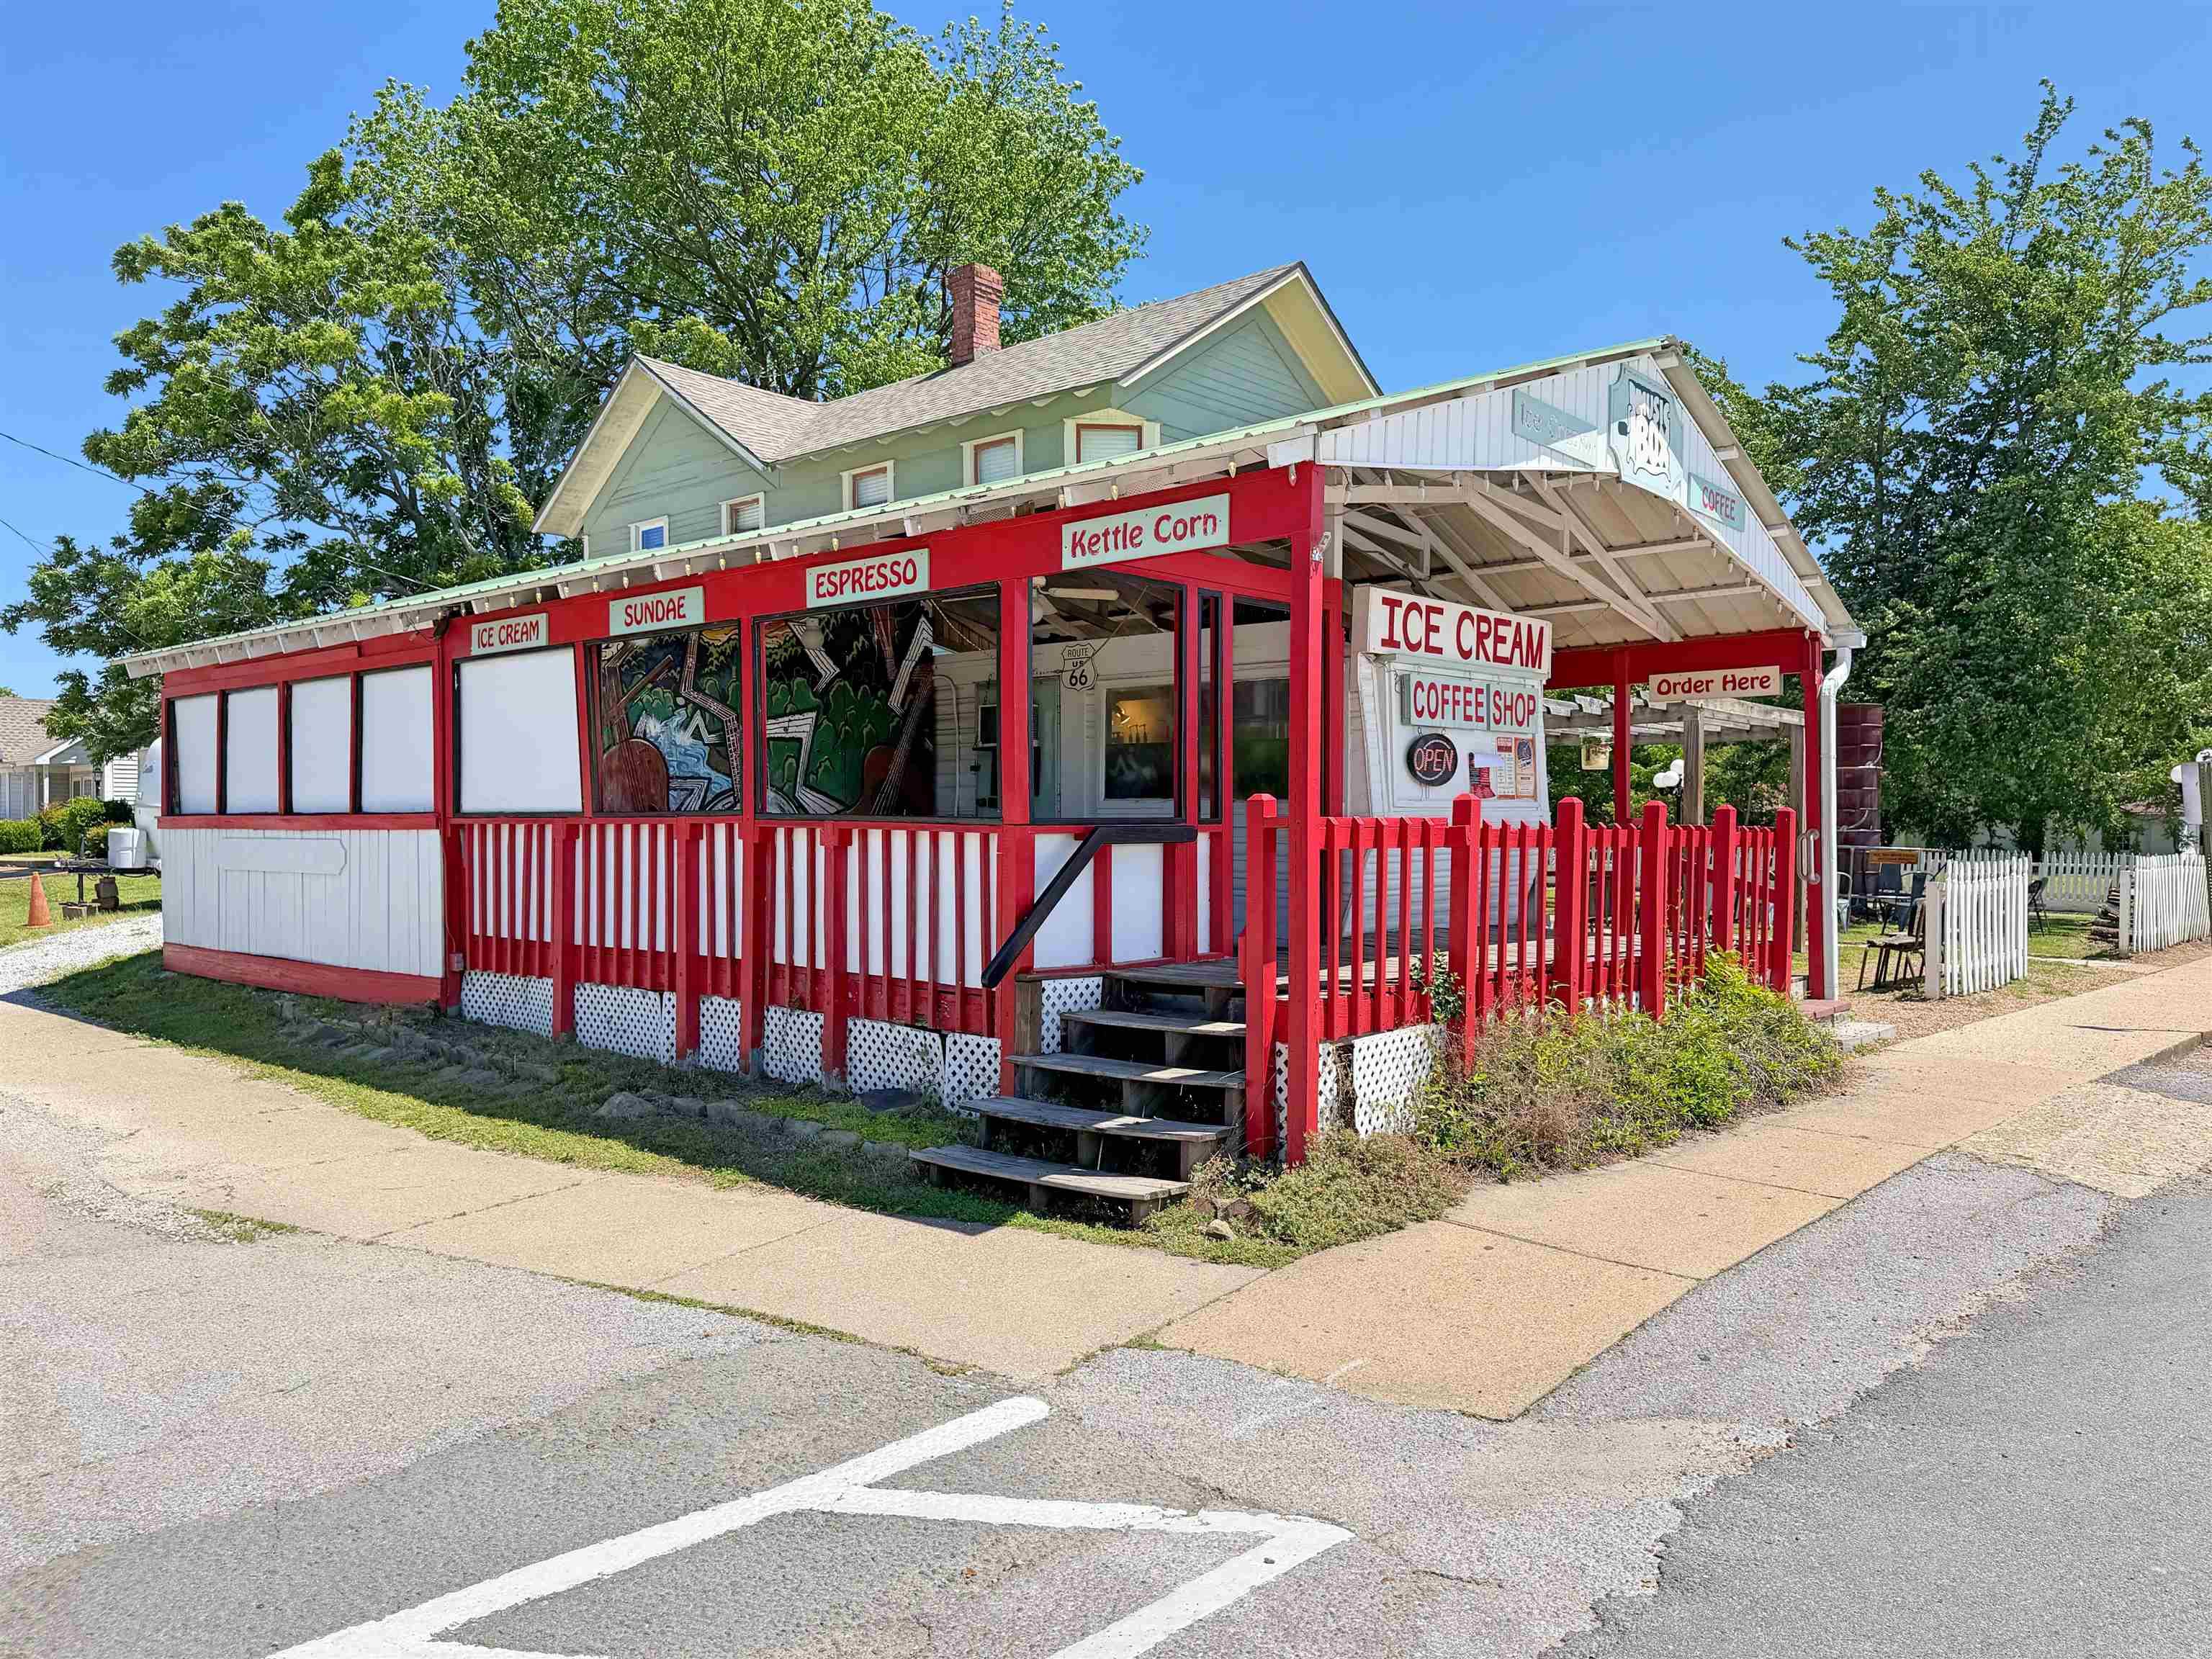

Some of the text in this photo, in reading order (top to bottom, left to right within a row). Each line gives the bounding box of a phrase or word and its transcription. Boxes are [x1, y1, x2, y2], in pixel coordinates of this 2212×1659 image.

[1702, 485, 1736, 521] COFFEE
[1071, 513, 1217, 558] Kettle Corn
[815, 558, 917, 598] ESPRESSO
[624, 596, 686, 626] SUNDAE
[477, 620, 539, 649] ICE CREAM
[1381, 597, 1545, 669] ICE CREAM
[1067, 648, 1089, 657] ROUTE
[1069, 669, 1087, 686] 66
[1658, 674, 1770, 696] Order Here
[1413, 680, 1536, 727] COFFEE SHOP
[1413, 748, 1455, 773] OPEN
